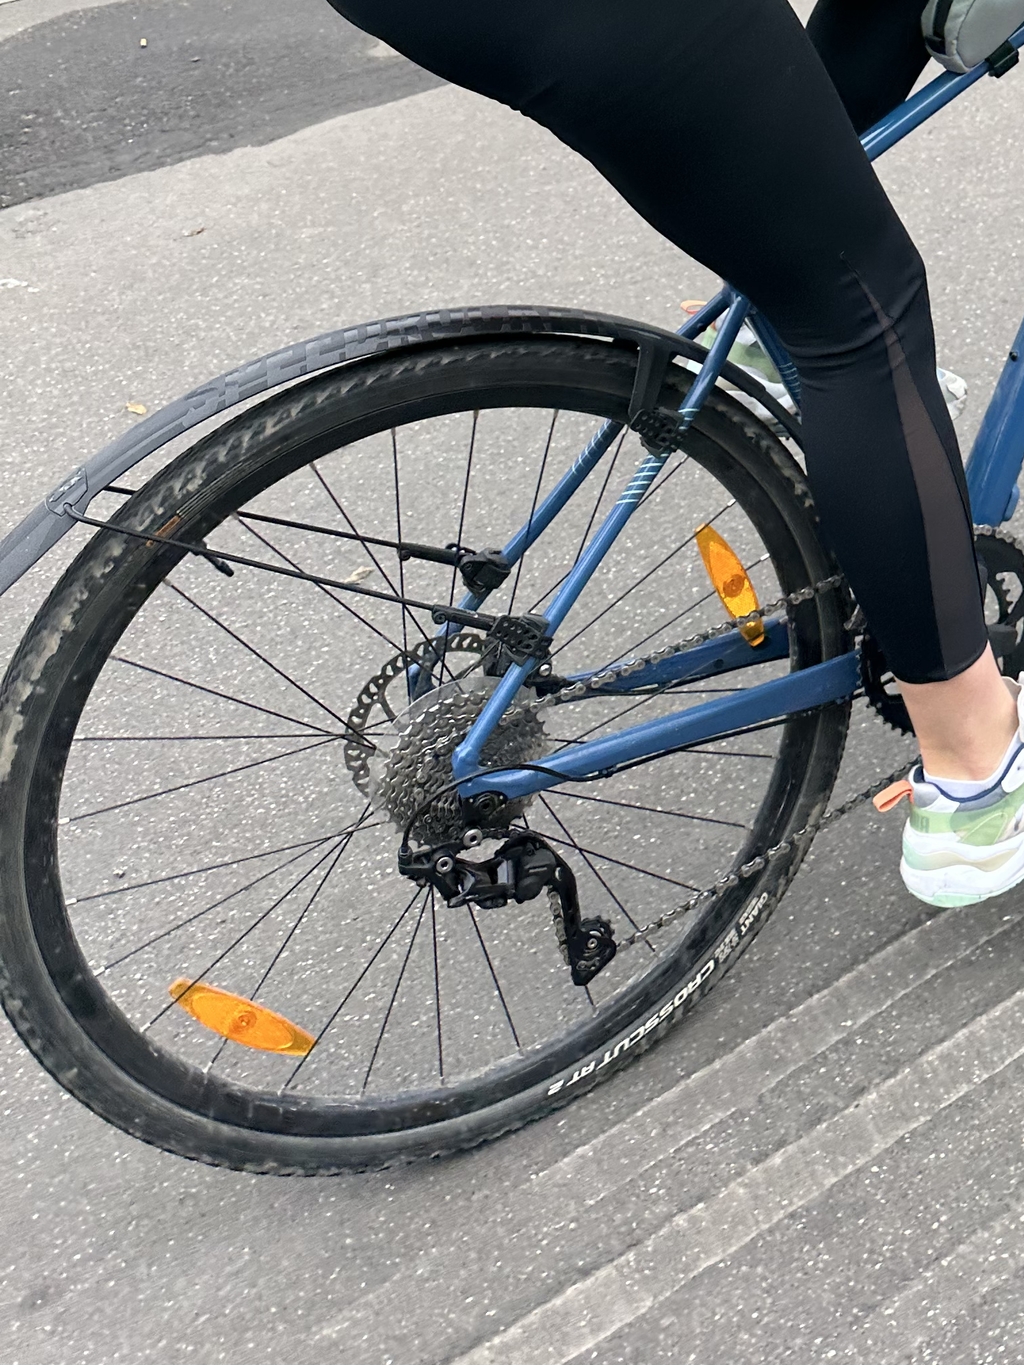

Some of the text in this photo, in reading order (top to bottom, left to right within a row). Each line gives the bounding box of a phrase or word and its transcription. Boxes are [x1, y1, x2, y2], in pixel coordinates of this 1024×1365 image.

[740, 892, 769, 936] GIANT
[596, 959, 715, 1071] CROSSCUT
[547, 1079, 563, 1096] 2
